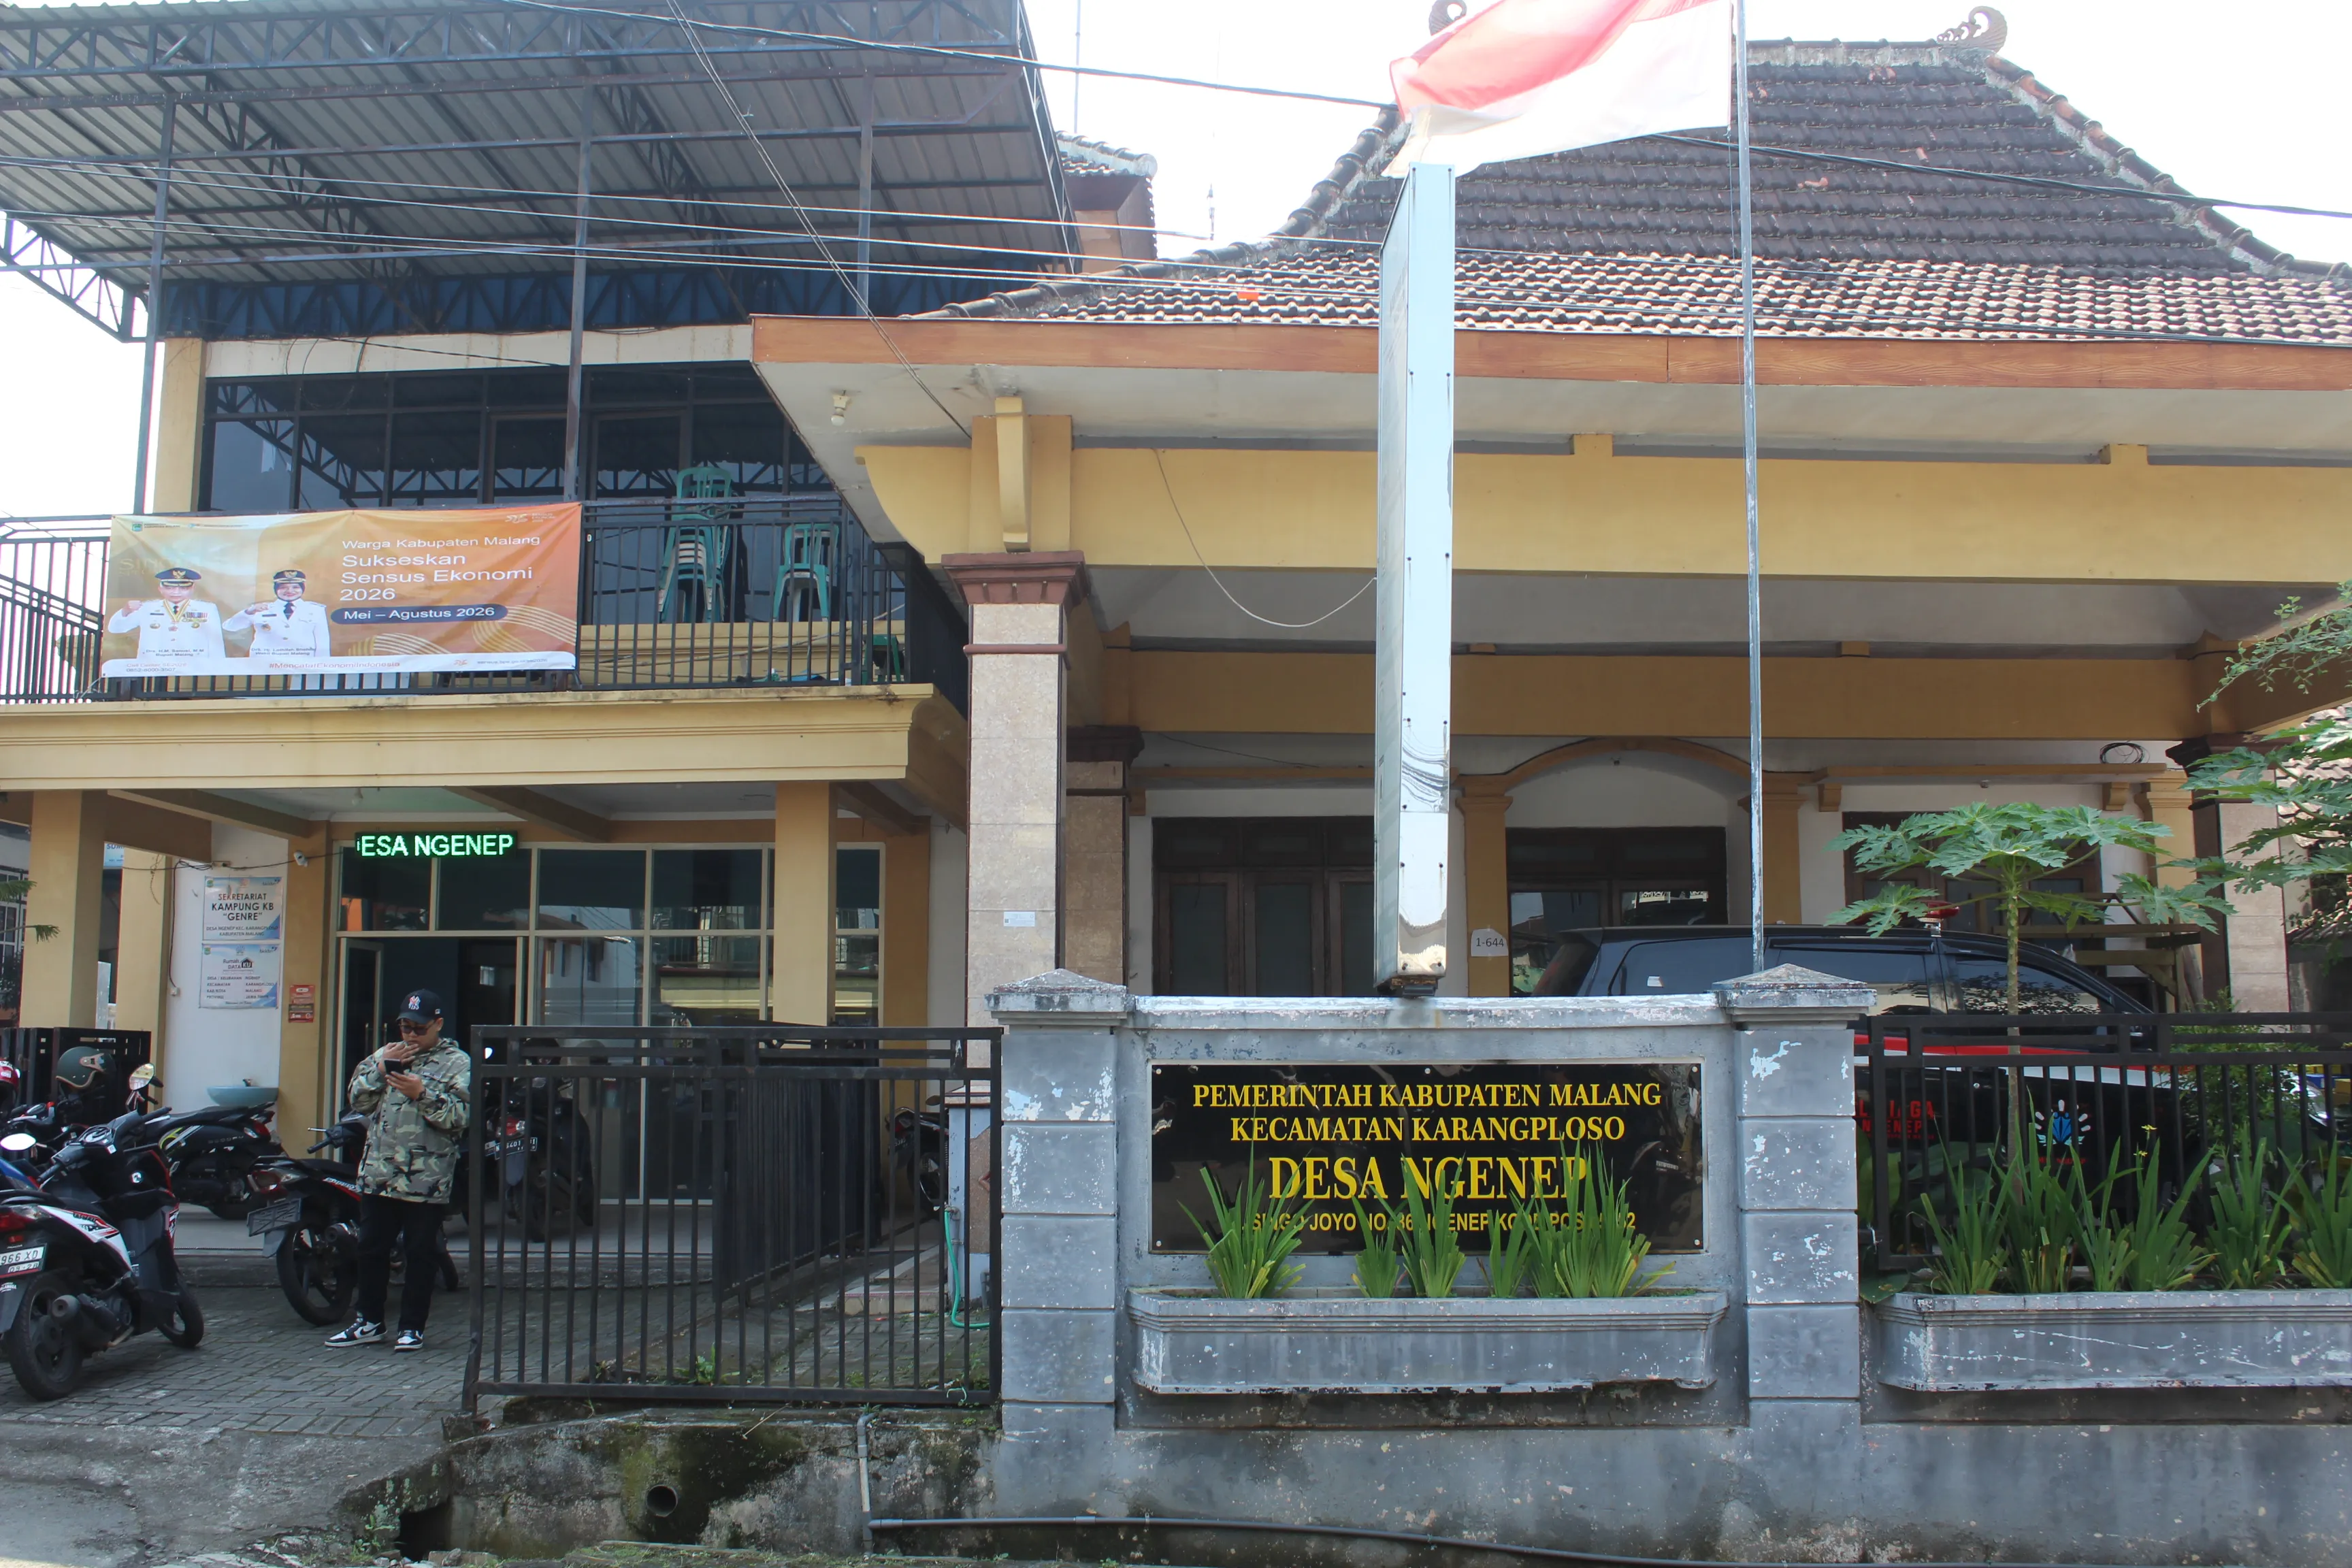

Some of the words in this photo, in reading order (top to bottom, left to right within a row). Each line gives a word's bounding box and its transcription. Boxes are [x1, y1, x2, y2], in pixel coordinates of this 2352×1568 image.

[342, 540, 391, 550] Warga
[397, 538, 478, 549] Kabupaten
[485, 537, 540, 546] Malang
[342, 554, 466, 567] Sukseskan
[341, 572, 425, 584] Sensus
[434, 567, 532, 582] Ekonomi
[340, 588, 396, 601] 2026
[344, 610, 371, 619] Mei
[389, 610, 451, 621] Agustus
[456, 607, 495, 617] 2026
[357, 835, 409, 857] ESA
[414, 834, 513, 856] NGENEP
[212, 902, 259, 911] KAMPUNG
[263, 902, 274, 911] KB
[1475, 937, 1504, 947] 1-644
[1194, 1084, 1372, 1107] PEMERINTAH
[1379, 1084, 1541, 1107] KABUPATEN
[1549, 1083, 1661, 1107] MALANG
[1230, 1117, 1404, 1141] KECAMATAN
[1412, 1116, 1625, 1141] KARANGPLOSO
[1861, 1120, 1923, 1133] NENEP
[1269, 1157, 1389, 1199] DESA
[1401, 1156, 1587, 1199] NGENEP
[1309, 1213, 1356, 1231] JOYO
